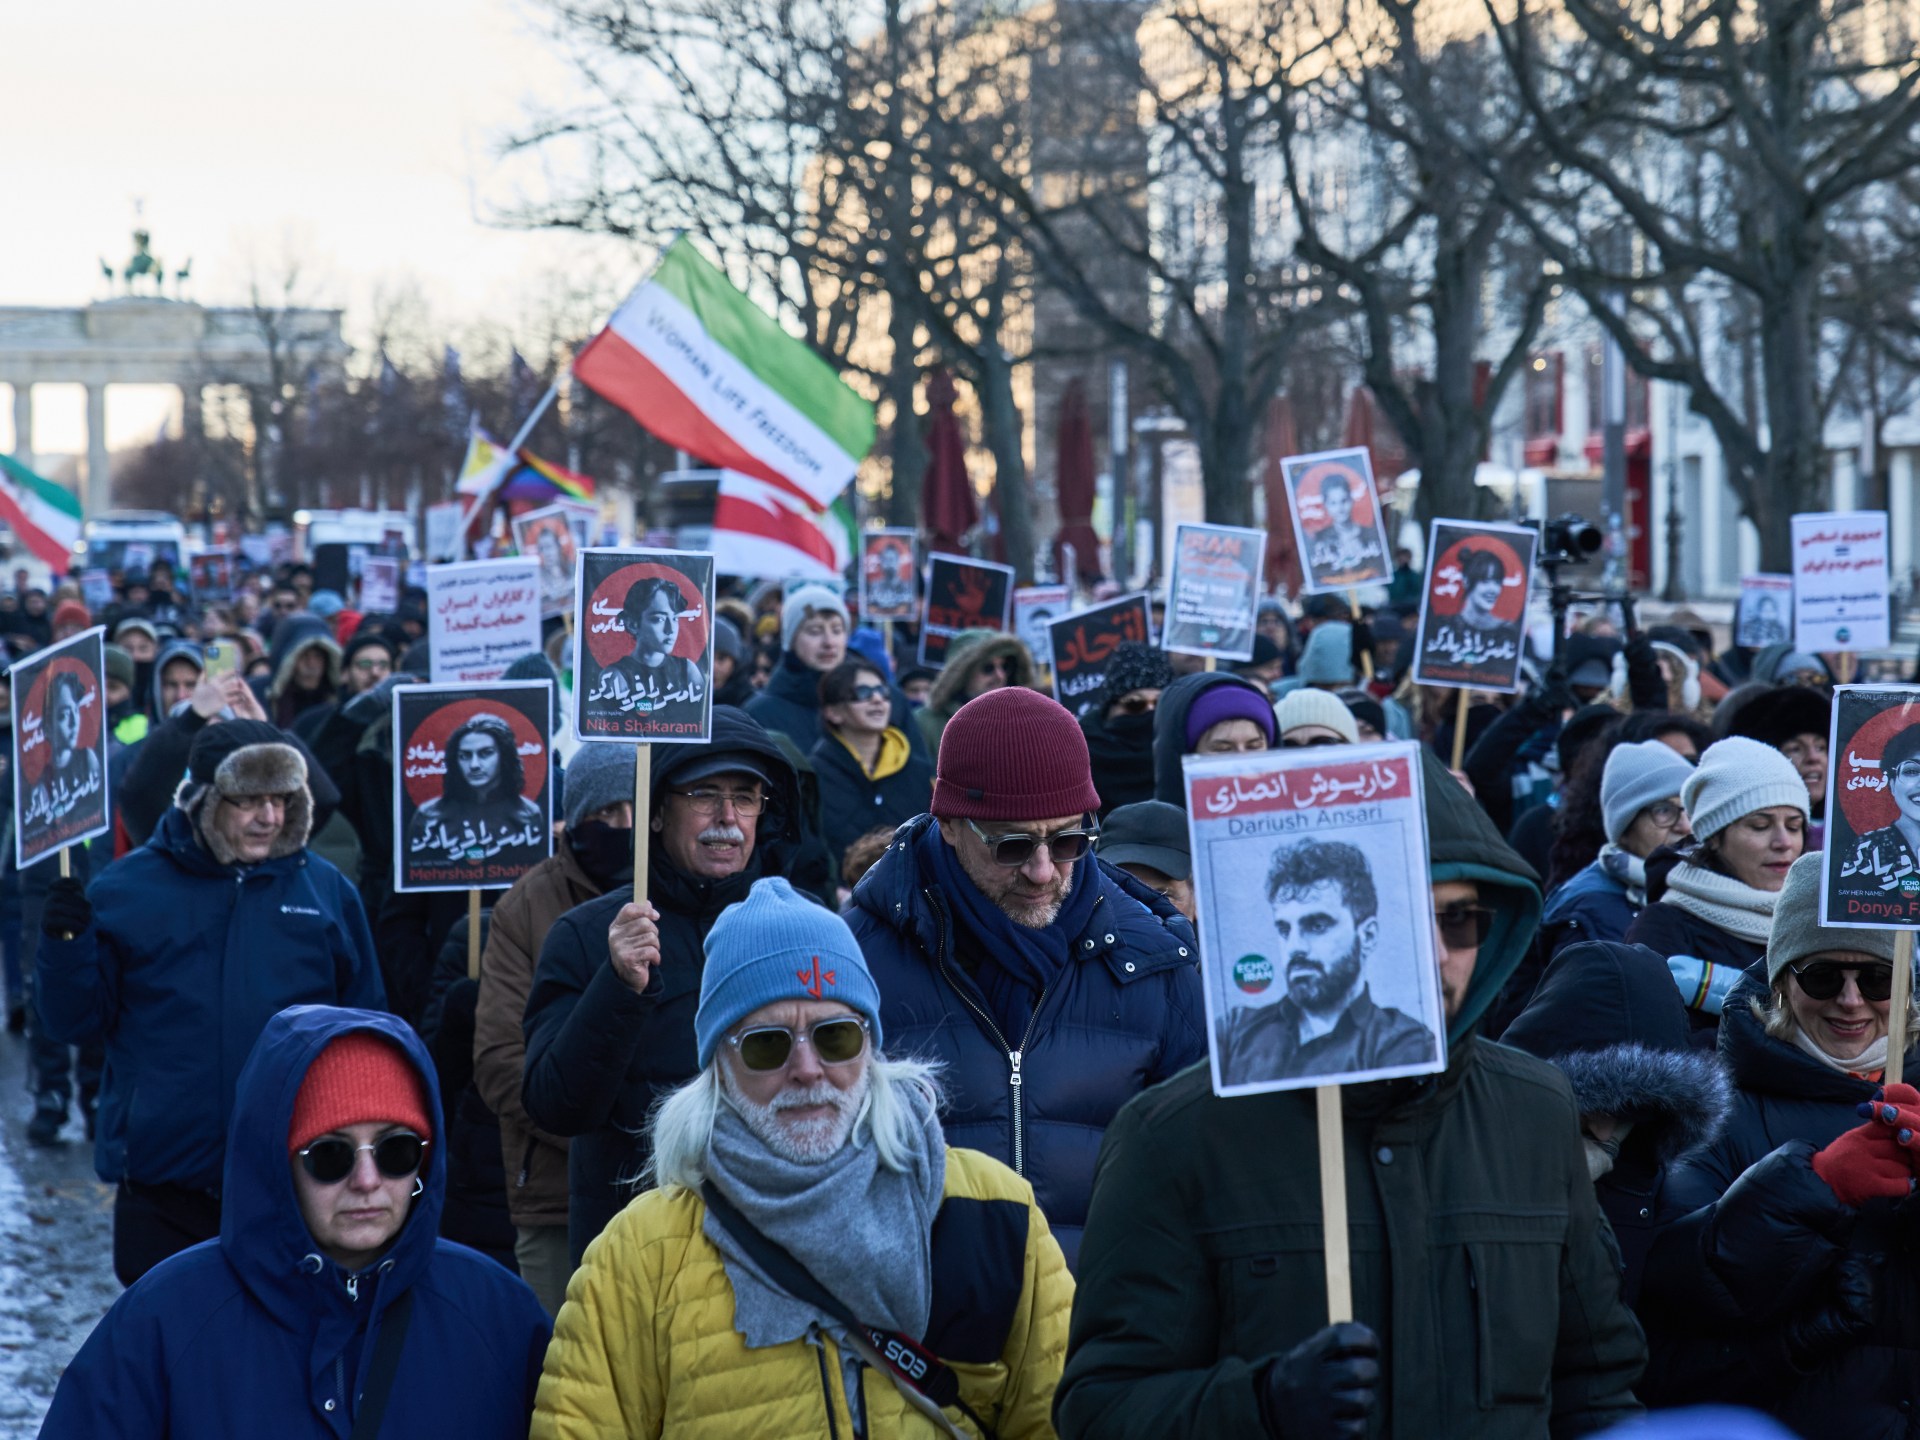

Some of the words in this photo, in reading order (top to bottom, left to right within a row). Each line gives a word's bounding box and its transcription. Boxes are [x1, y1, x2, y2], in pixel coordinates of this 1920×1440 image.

[648, 309, 711, 379] WOMAN
[712, 374, 746, 411] LIFE
[748, 407, 823, 477] FREEDOM
[1843, 693, 1872, 701] WOMAN
[586, 718, 619, 732] Nika
[624, 719, 703, 733] Shakarami
[1293, 763, 1398, 809] داریوش
[1846, 771, 1888, 792] فرهادی
[1205, 773, 1288, 814] انصاری
[1228, 812, 1309, 836] Dariush
[1316, 804, 1383, 827] Ansari
[409, 866, 484, 881] Mehrshad
[1848, 899, 1902, 917] Donya
[1236, 961, 1270, 974] ECHO
[1243, 971, 1273, 983] IRAN
[884, 1339, 928, 1380] EOS
